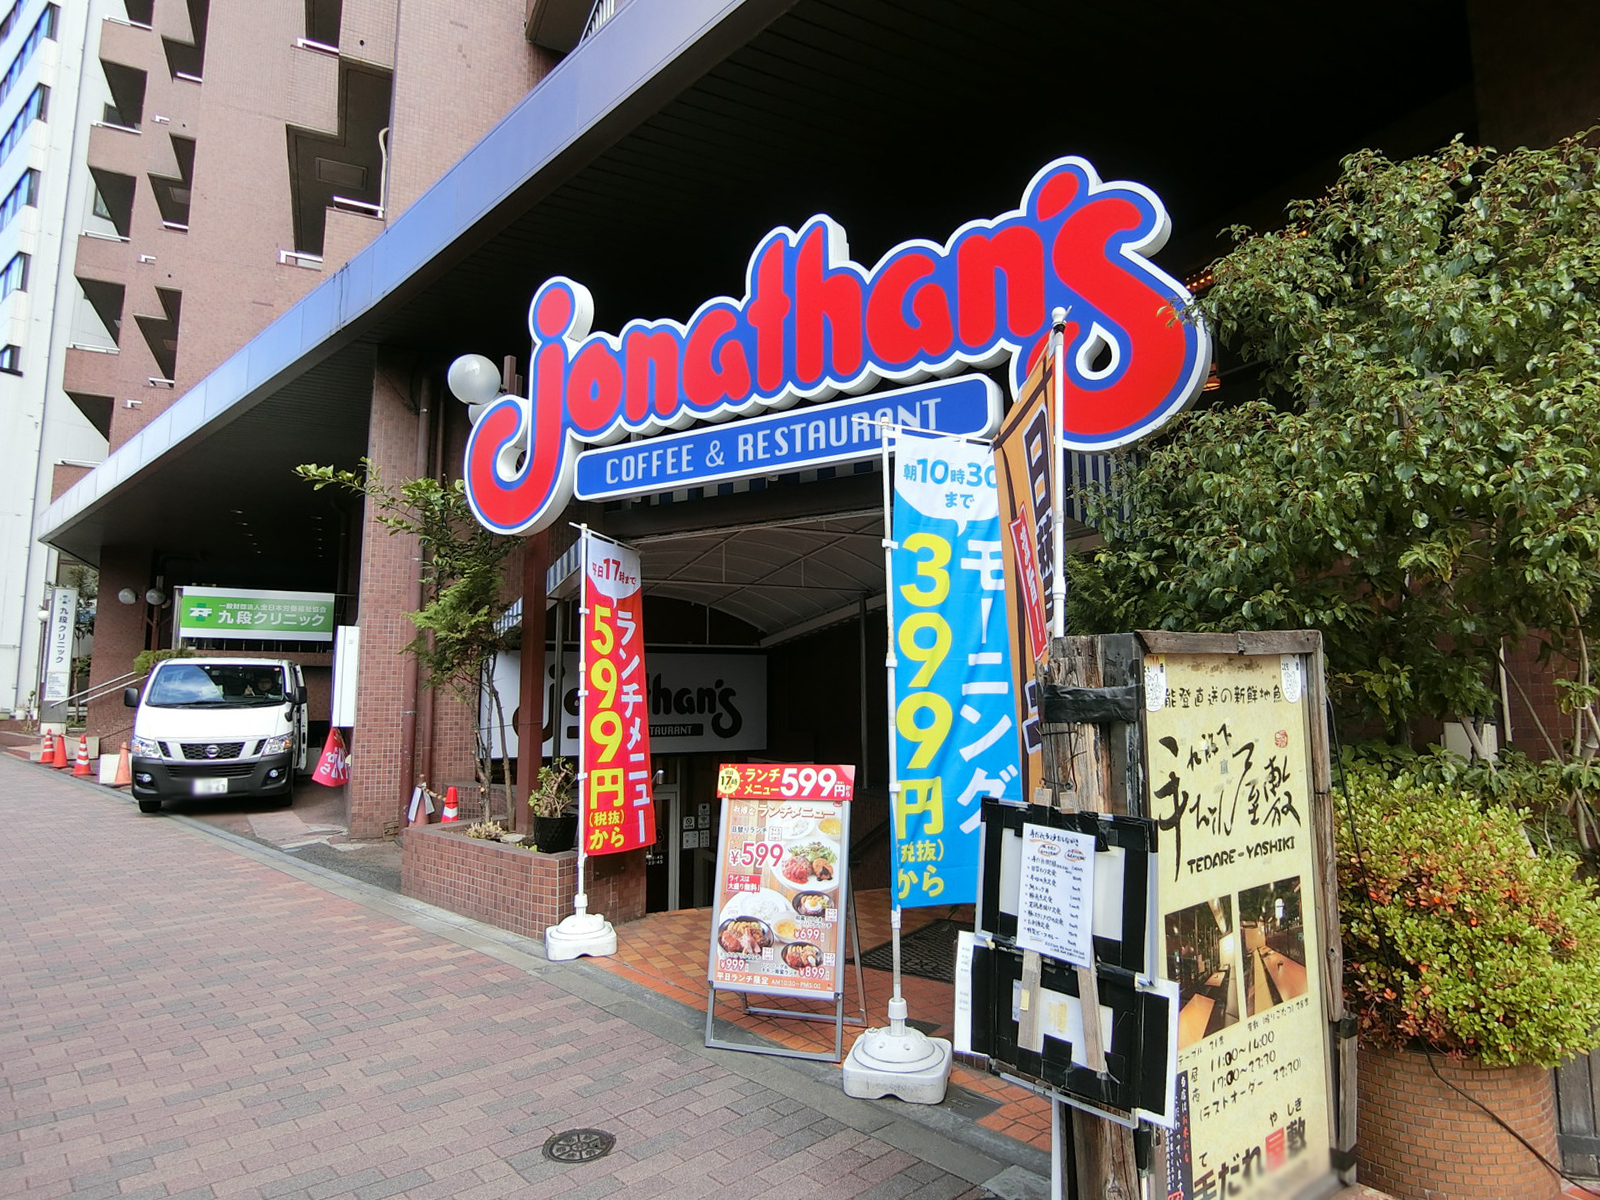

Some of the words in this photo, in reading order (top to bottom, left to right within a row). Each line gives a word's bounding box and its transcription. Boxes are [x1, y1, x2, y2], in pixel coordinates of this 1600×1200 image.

[466, 160, 1204, 532] jonathan's
[604, 443, 694, 485] COFFEE
[705, 440, 725, 468] &
[737, 397, 942, 463] RESTAURANT
[944, 491, 975, 509] まで
[217, 610, 325, 628] 九段クリニック
[55, 607, 69, 664] 九段クリニック
[896, 532, 954, 840] 399円
[957, 538, 1018, 835] モーニング
[589, 603, 625, 810] 599円
[616, 610, 651, 844] ランチメニュー
[745, 767, 781, 783] ランチ
[743, 784, 780, 796] メニュー
[757, 803, 835, 819] ランチメニュー
[589, 827, 625, 851] から
[729, 841, 785, 868] ¥599
[794, 928, 820, 940] ¥699
[719, 958, 745, 971] ¥999
[799, 966, 826, 978] ¥899
[1198, 1151, 1208, 1168] て
[1269, 1111, 1278, 1127] や
[1286, 1097, 1303, 1116] しき
